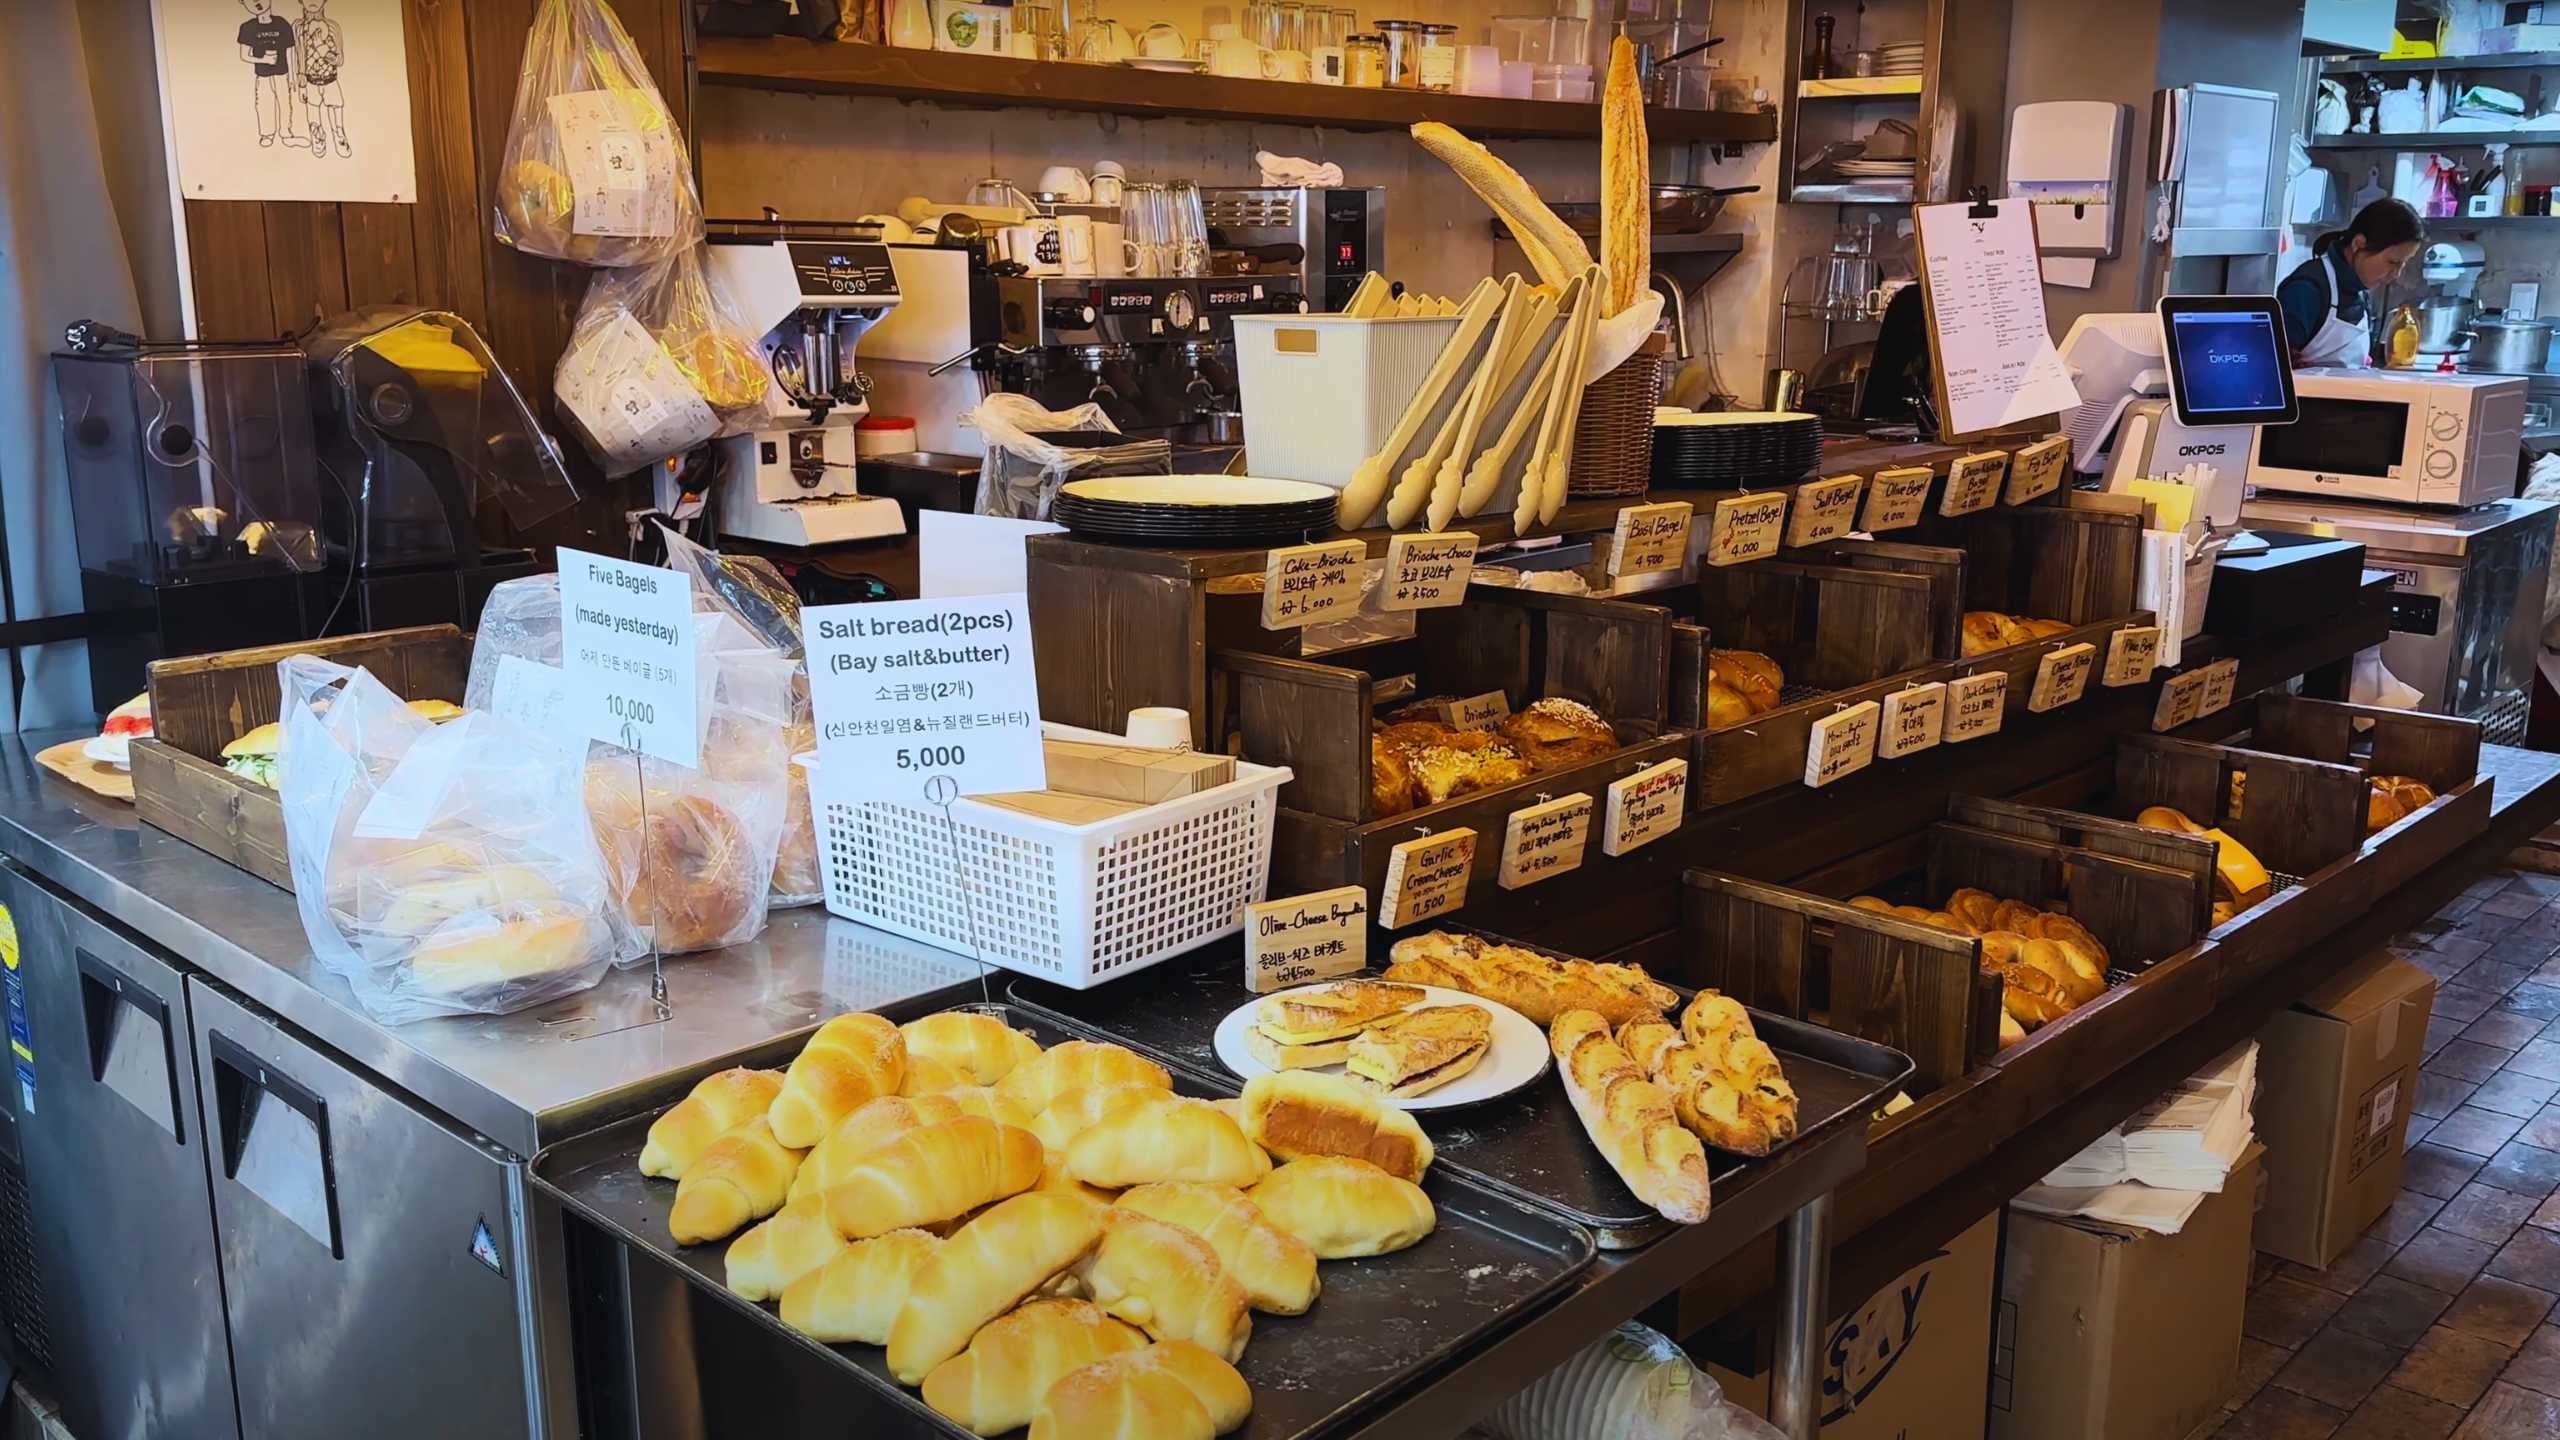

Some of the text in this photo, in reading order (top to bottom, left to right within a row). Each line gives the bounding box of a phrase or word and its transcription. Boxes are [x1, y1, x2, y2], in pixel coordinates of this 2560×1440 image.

[2209, 354, 2248, 364] OKPOS
[2179, 444, 2226, 457] OKPOS
[589, 564, 657, 594] Five Bagels
[575, 603, 679, 646] (made yesterday)
[819, 609, 1013, 639] Salt bread(2pcs)
[830, 644, 1010, 675] (Bay salt&butter)
[874, 680, 974, 701] 소금빵(2개)
[606, 694, 654, 724] 10,000
[825, 711, 1030, 740] (신안천일염&뉴질랜드버터)
[896, 745, 966, 771] 5,000
[1420, 847, 1454, 867] Garlic
